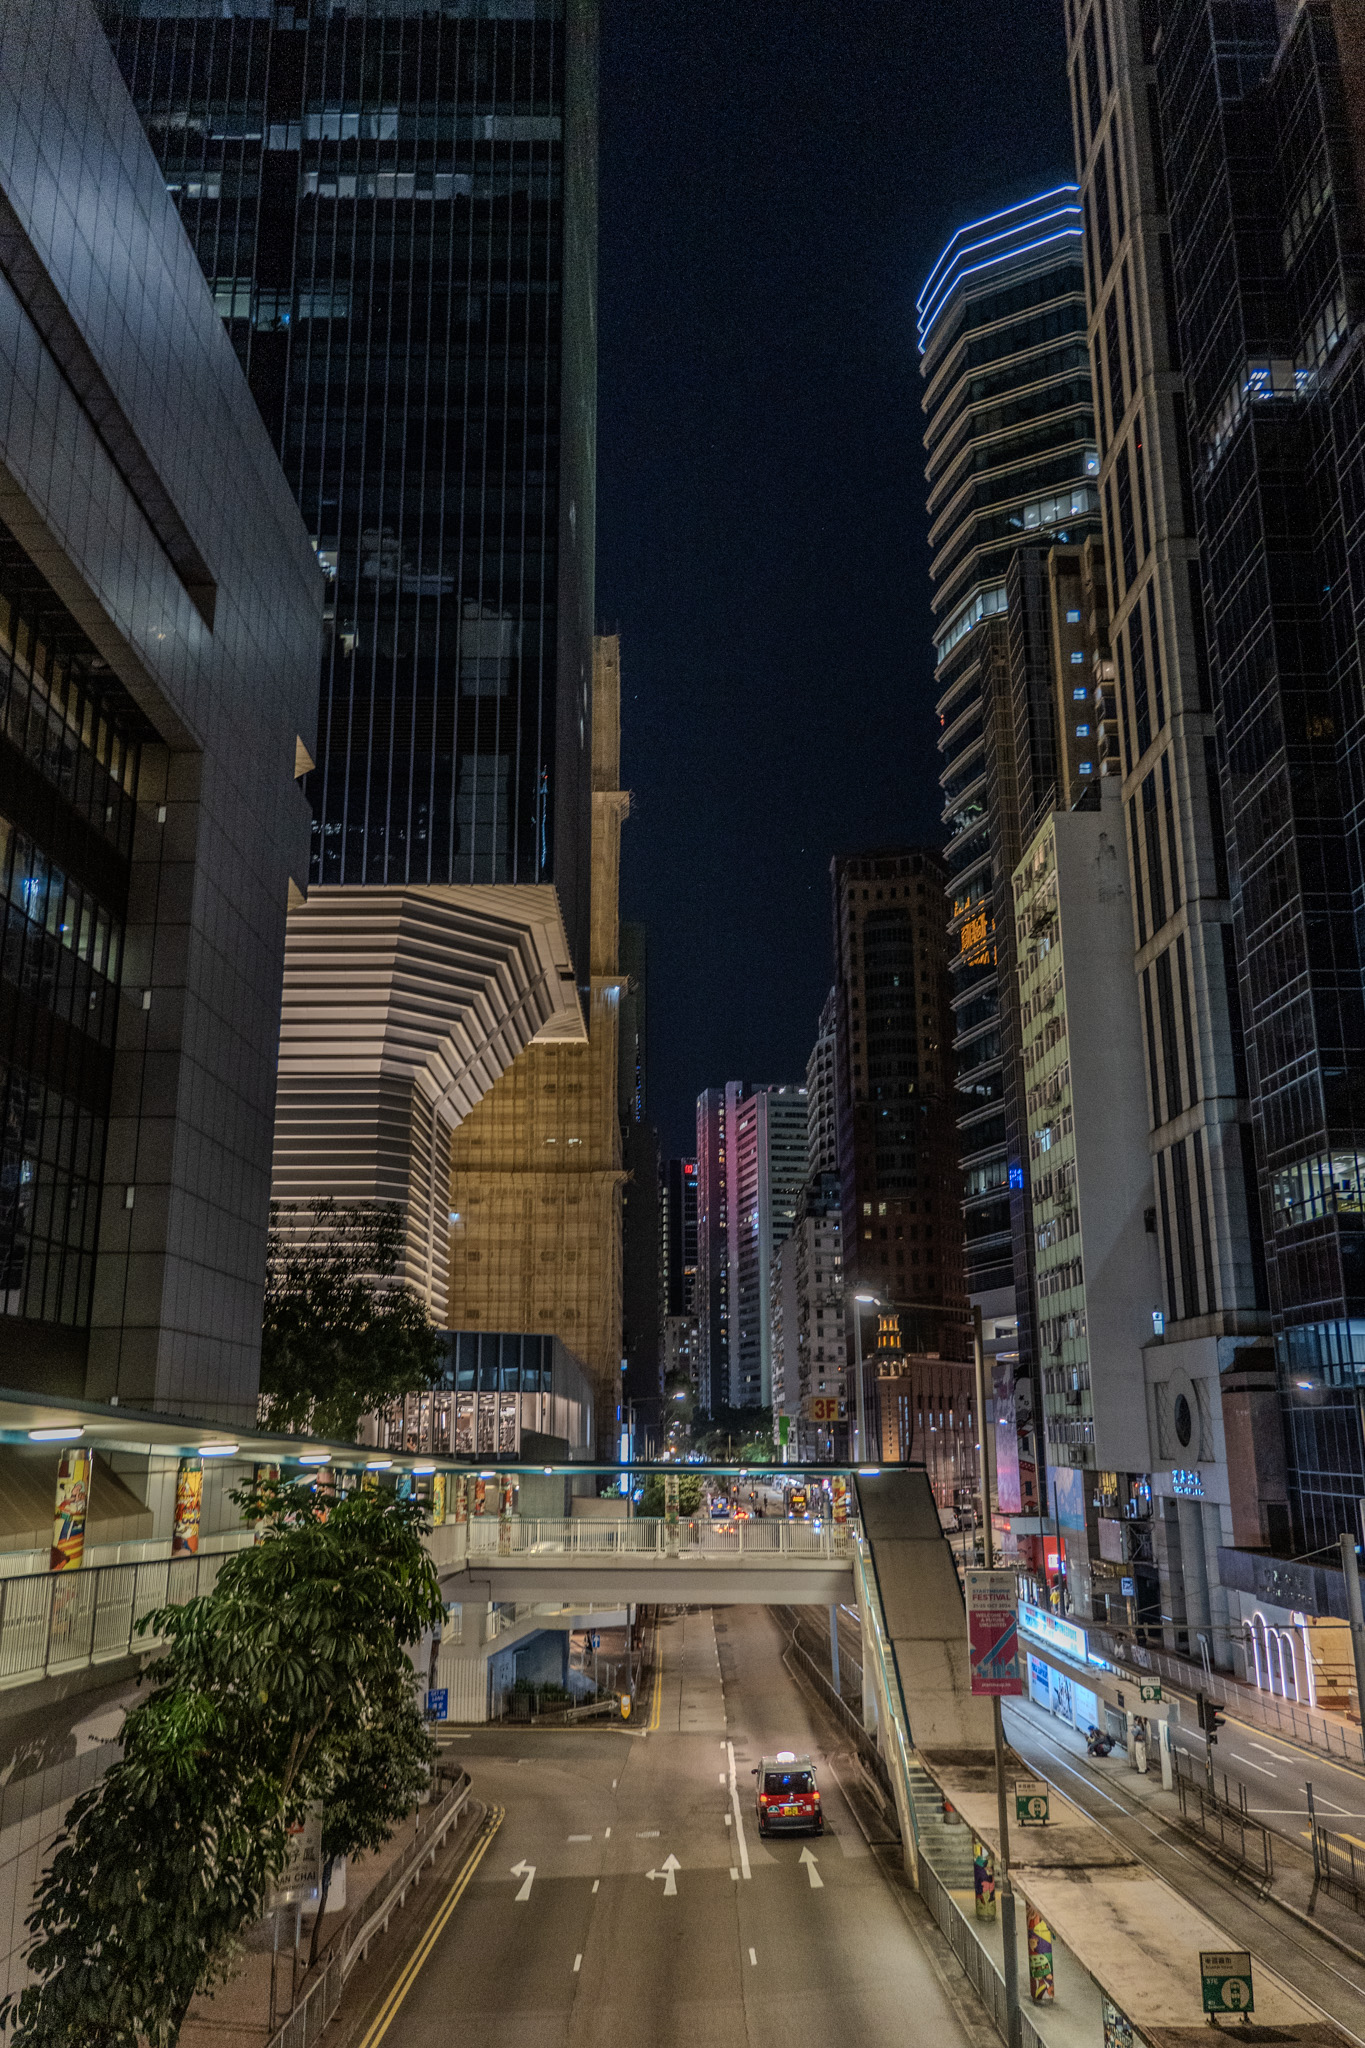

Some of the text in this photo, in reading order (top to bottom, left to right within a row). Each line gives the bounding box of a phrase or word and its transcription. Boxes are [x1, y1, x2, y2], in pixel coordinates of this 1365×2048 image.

[815, 1399, 836, 1419] 3F
[972, 1593, 1011, 1601] FESTIVAL
[295, 1871, 316, 1881] CHAI
